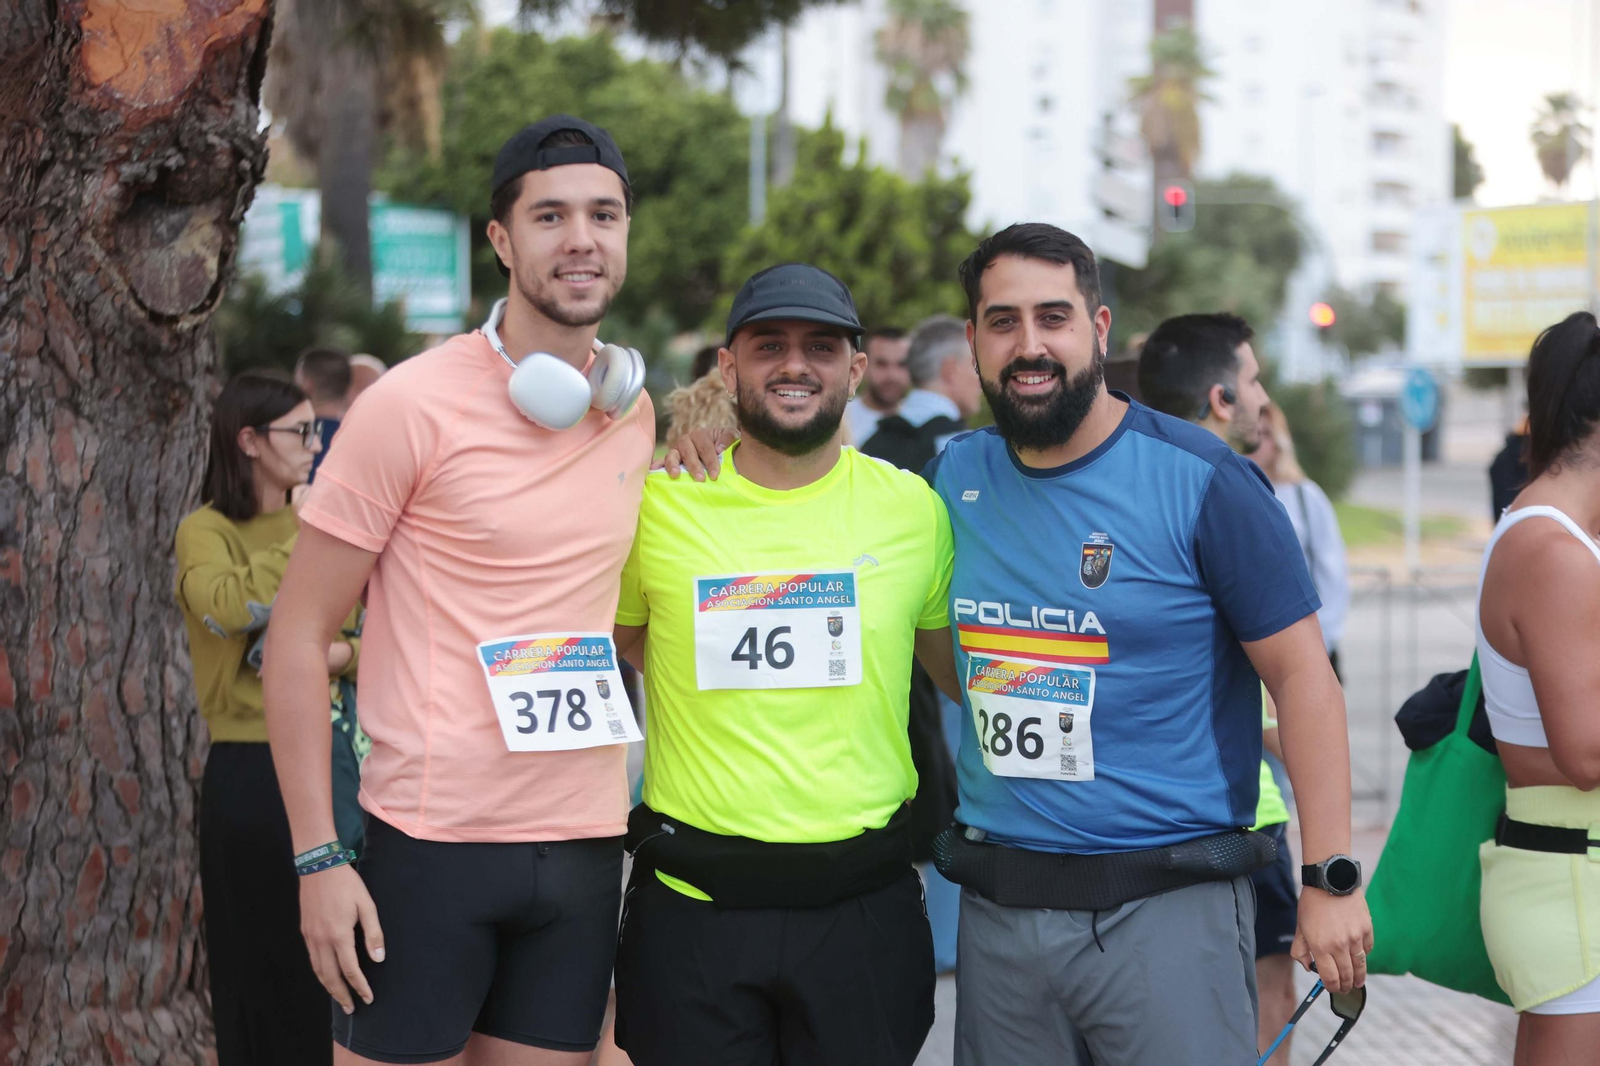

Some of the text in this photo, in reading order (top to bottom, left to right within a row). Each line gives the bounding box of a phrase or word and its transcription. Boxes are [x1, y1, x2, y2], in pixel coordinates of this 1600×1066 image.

[706, 595, 851, 608] ASOCIACION SANTO ANGEL
[709, 581, 844, 598] CARRERA POPULAR
[493, 645, 605, 661] CARRERA POPULAR
[731, 626, 795, 670] 46
[495, 659, 612, 672] ASOCIACION SANTO ANGEL
[975, 665, 1080, 690] CARRERA POPULAR
[971, 678, 1085, 702] ASOCIACION SANTO ANGEL
[508, 688, 592, 734] 378
[979, 708, 1044, 760] 286
